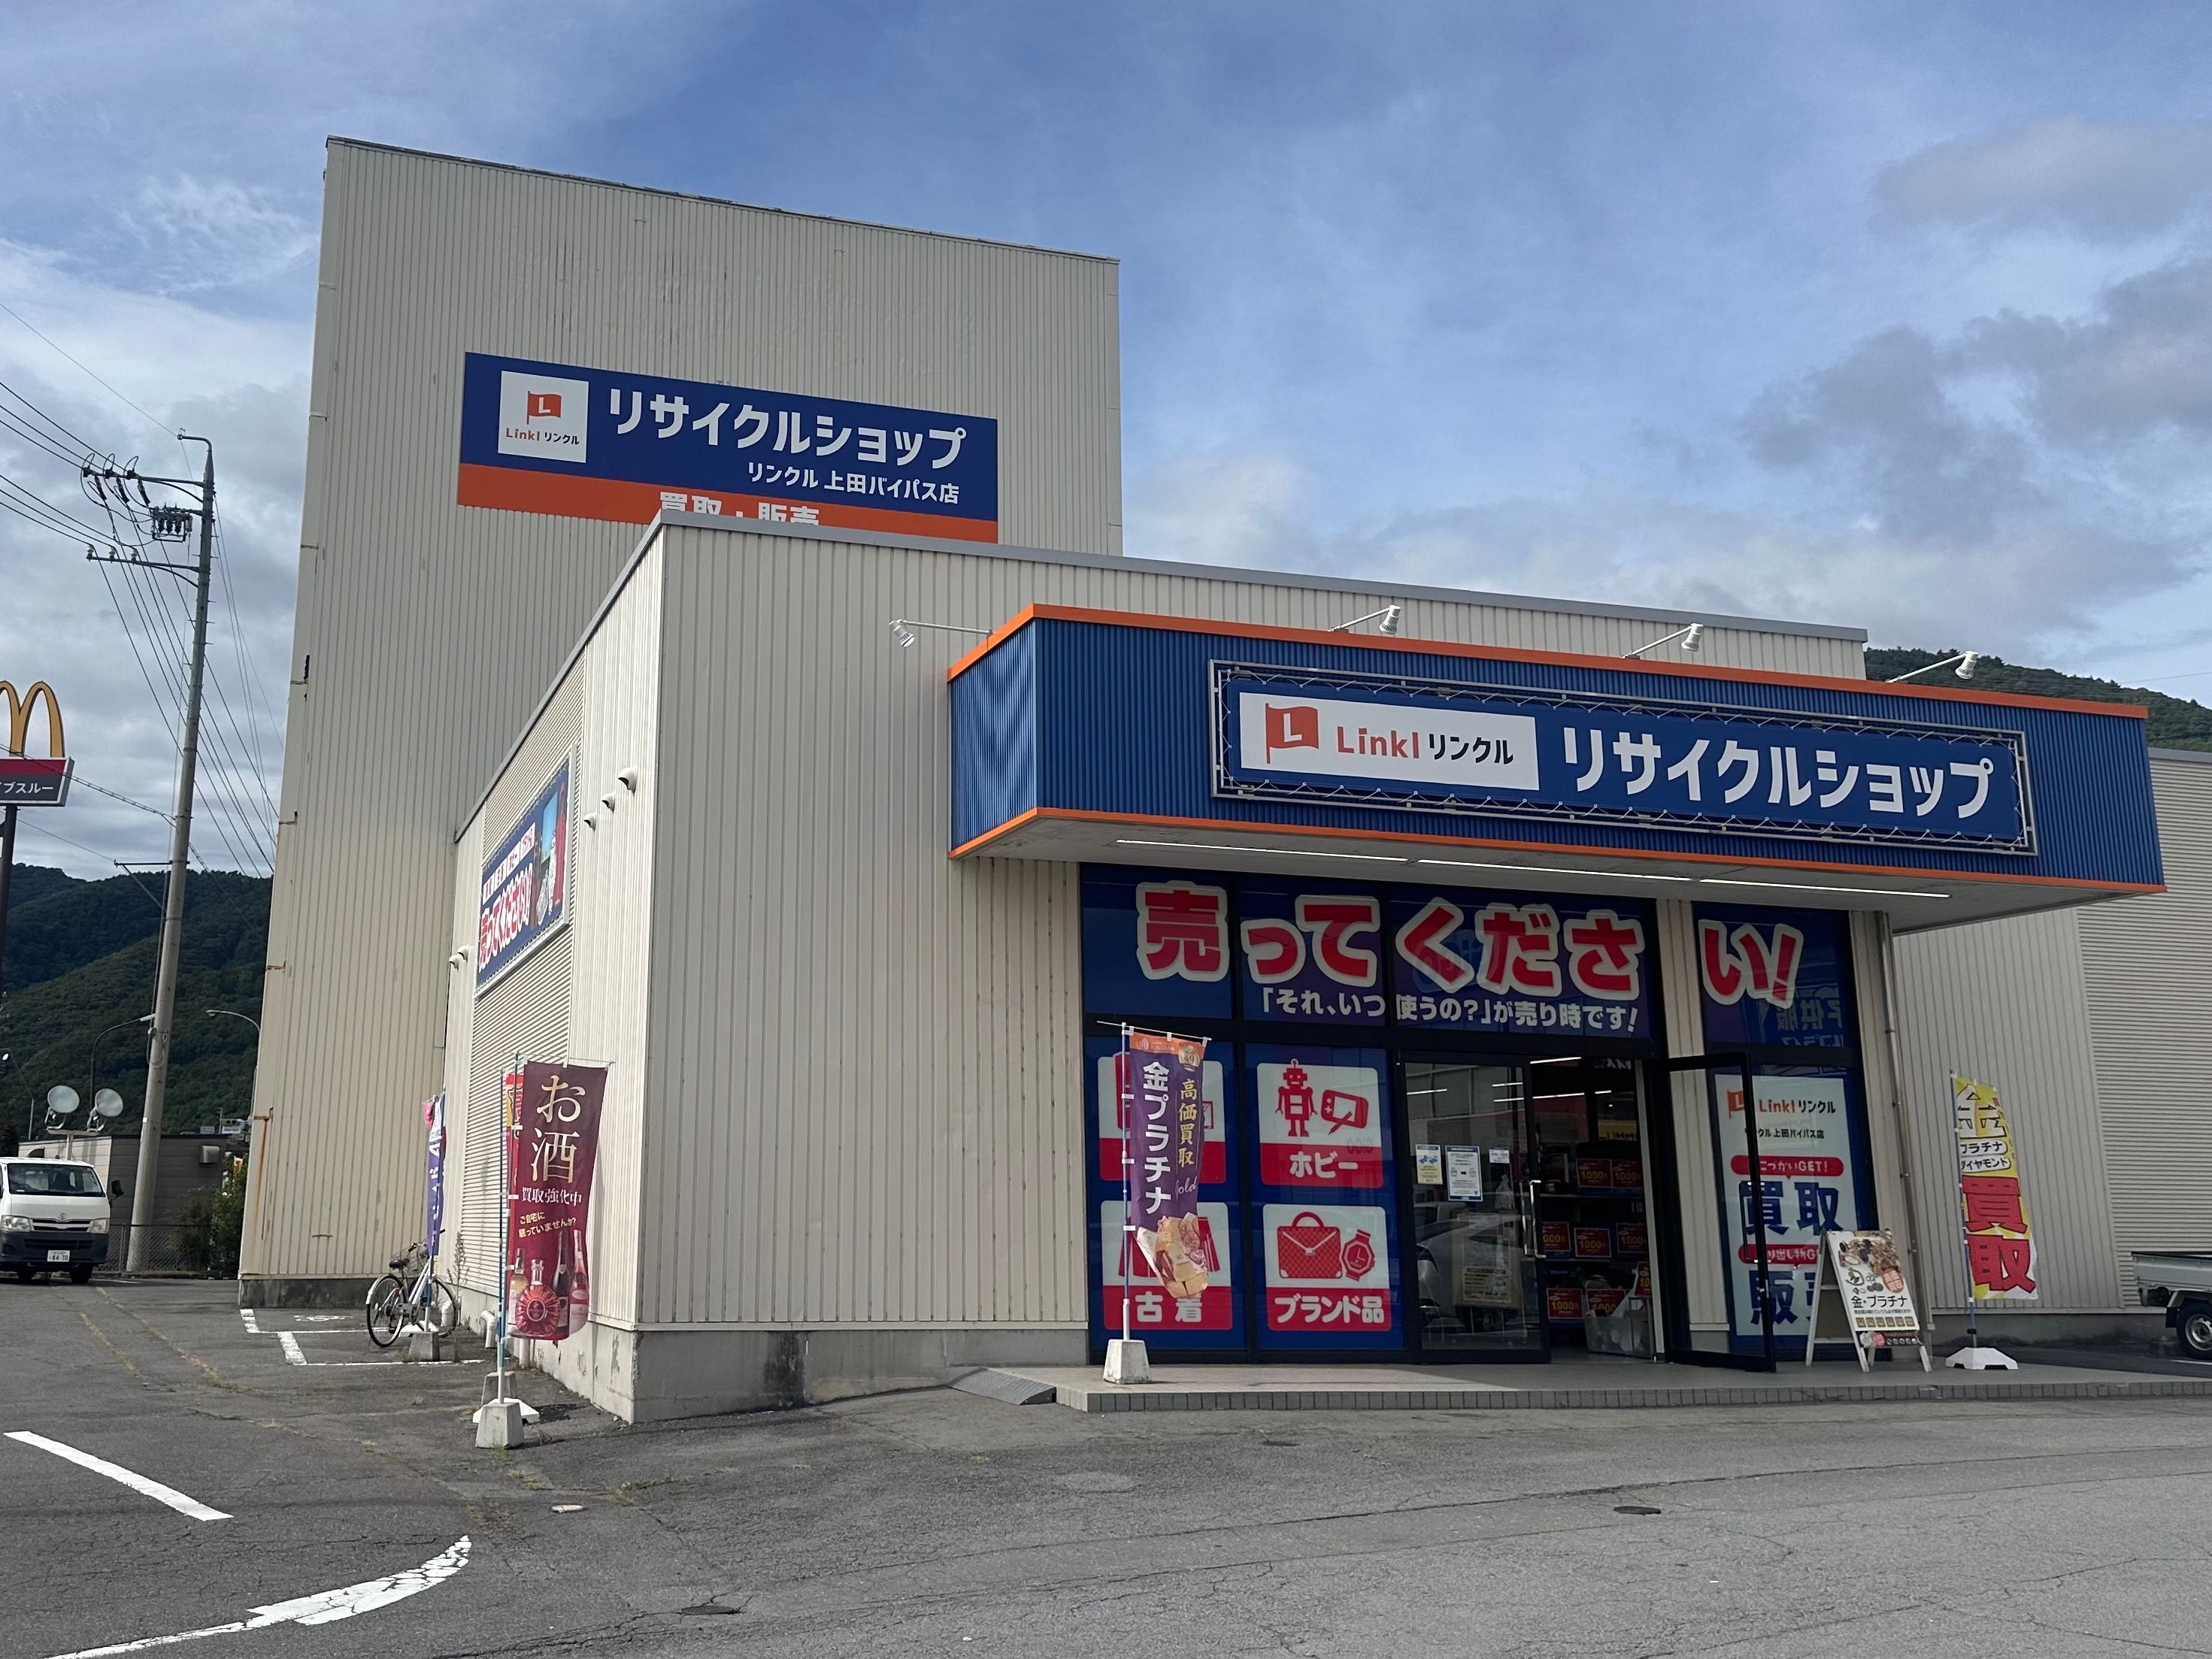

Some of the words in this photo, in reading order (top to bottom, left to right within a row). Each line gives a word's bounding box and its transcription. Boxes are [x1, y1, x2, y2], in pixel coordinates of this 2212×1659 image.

[544, 431, 579, 445] リンクル
[610, 388, 967, 469] リサイクルショップ
[748, 462, 818, 488] リンクル
[824, 471, 959, 504] 上田バイパス店
[1337, 726, 1420, 758] Linkl
[1429, 733, 1514, 765] リンクル
[1563, 727, 1994, 819] リサイクルショップ
[1177, 1078, 1198, 1168] 高価買取
[1798, 1100, 1836, 1113] リンクル
[531, 1075, 586, 1184] お酒
[1143, 1061, 1171, 1214] 金プラチナ
[1773, 1128, 1825, 1140] 上田バイパス店
[1289, 1151, 1359, 1179] ホビー
[522, 1186, 582, 1206] 買取強化中
[1962, 1175, 2036, 1293] 買取
[1135, 1291, 1203, 1323] 古着
[1274, 1293, 1385, 1324] ブランド品
